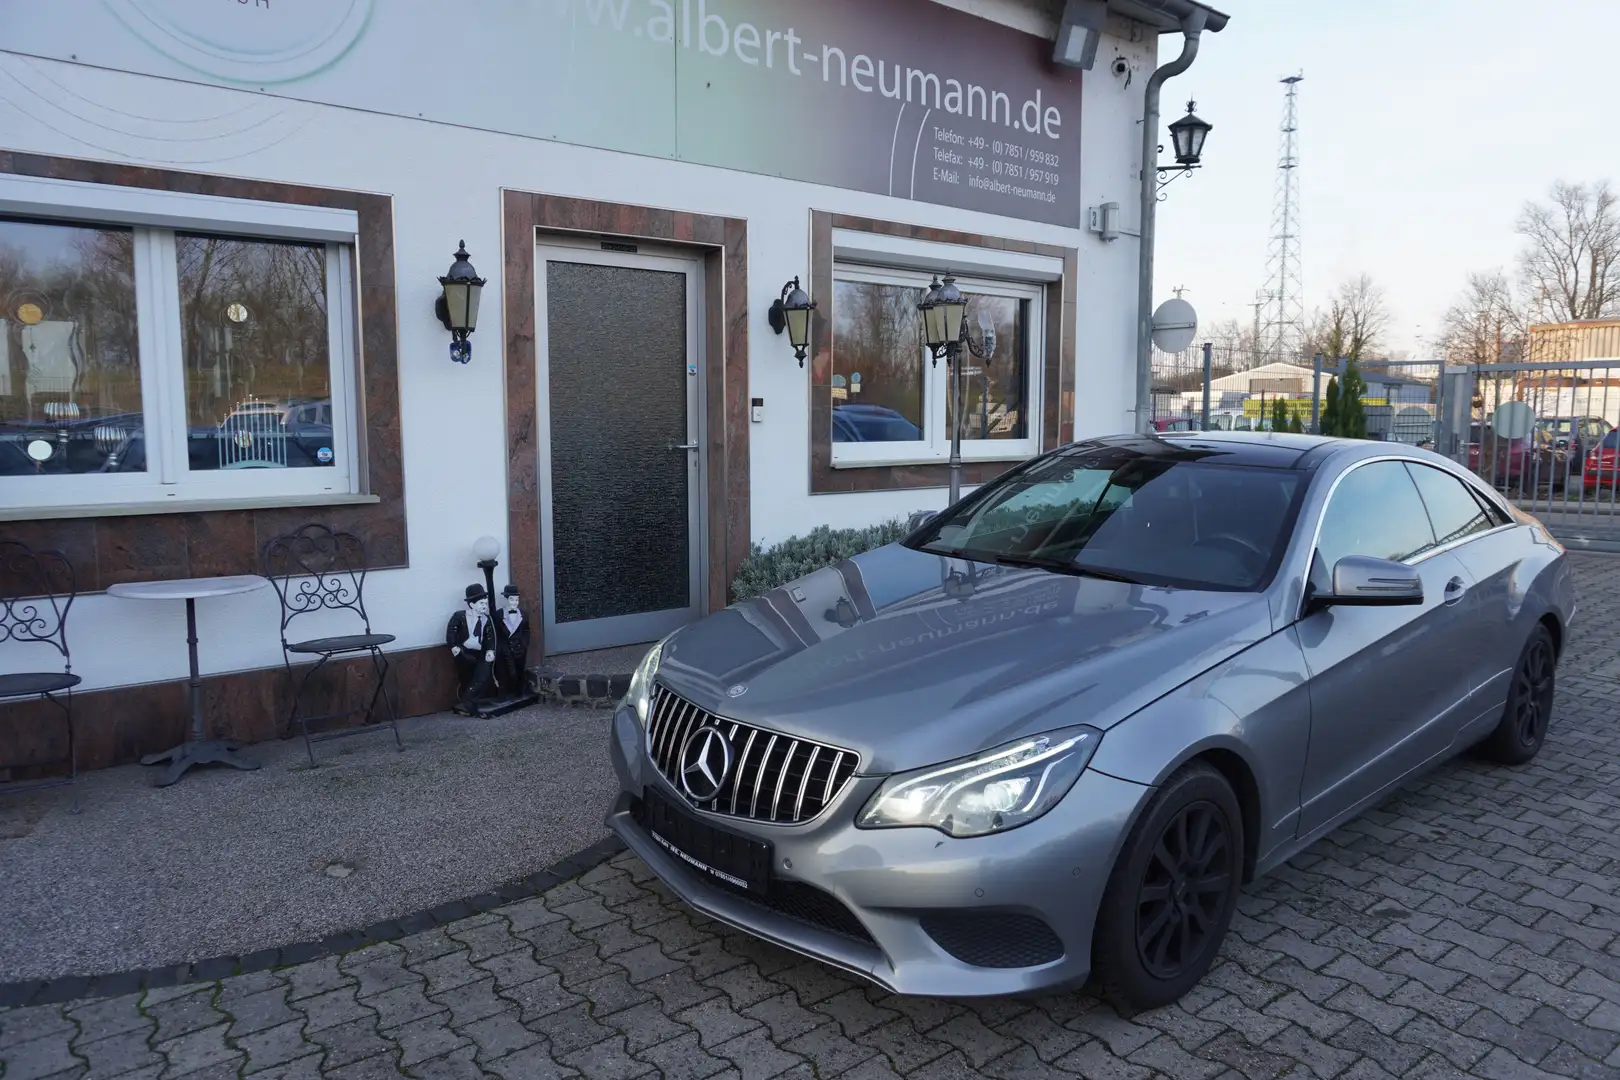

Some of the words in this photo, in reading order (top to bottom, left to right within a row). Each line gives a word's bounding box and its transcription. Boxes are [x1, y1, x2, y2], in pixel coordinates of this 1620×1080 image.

[933, 126, 965, 146] Telefon:
[992, 140, 1003, 156] (0)
[1004, 143, 1023, 158] 7851
[933, 146, 963, 165] Telefax:
[992, 160, 1003, 176] (0)
[1004, 162, 1023, 178] 7851
[933, 167, 960, 185] E-Mail:
[968, 174, 1056, 203] info@albert-neumann.de
